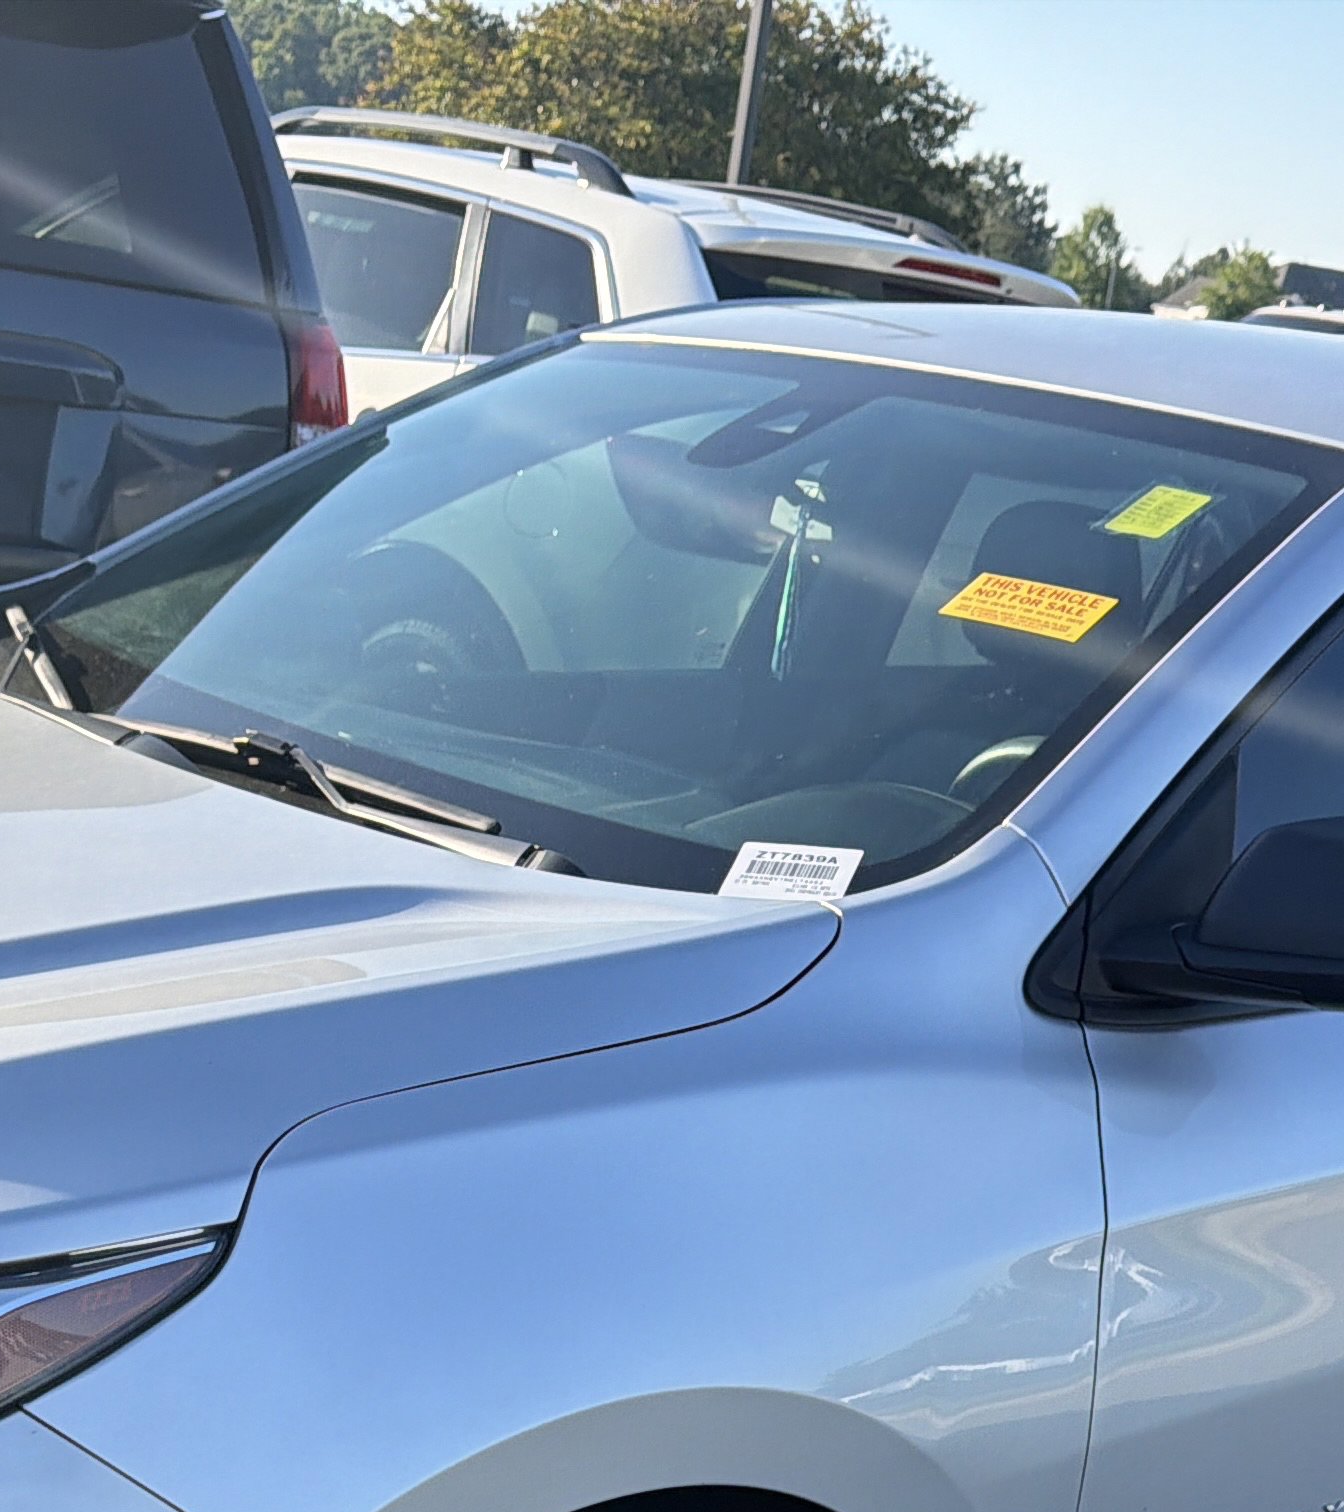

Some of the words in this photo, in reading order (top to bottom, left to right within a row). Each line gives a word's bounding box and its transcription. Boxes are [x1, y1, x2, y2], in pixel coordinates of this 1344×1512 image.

[974, 587, 1008, 601] NOT
[1008, 594, 1042, 608] FOR
[1044, 601, 1089, 618] SALE
[981, 576, 1024, 593] THIS
[1027, 583, 1105, 610] VEHICLE
